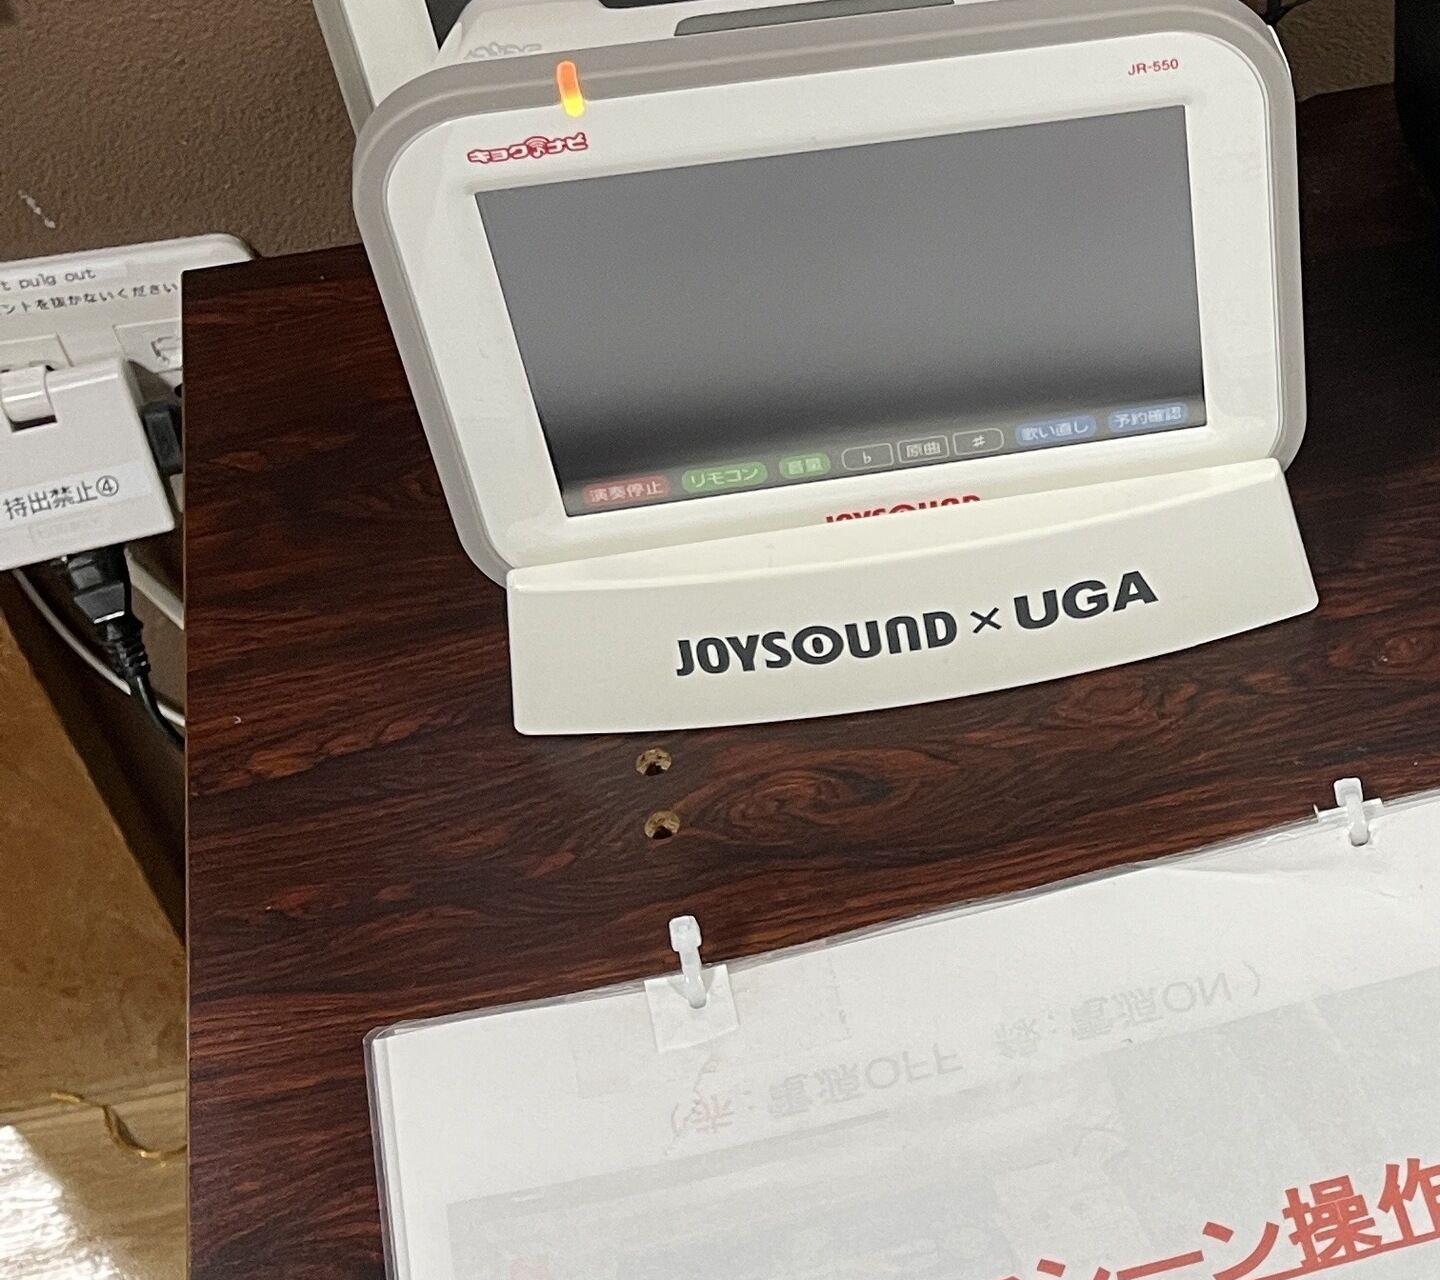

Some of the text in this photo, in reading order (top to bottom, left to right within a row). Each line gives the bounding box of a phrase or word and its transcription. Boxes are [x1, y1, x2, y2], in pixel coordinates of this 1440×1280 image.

[1127, 58, 1179, 76] JR-550
[64, 269, 97, 282] out
[589, 480, 664, 504] 演奏停止
[689, 467, 759, 489] リモコン
[905, 441, 942, 459] 原曲
[1021, 421, 1089, 443] 歌い直し
[1113, 405, 1182, 429] 予約確認
[3, 474, 120, 520] 持出禁止④
[676, 610, 958, 678] JOYSOUND
[1012, 570, 1160, 630] UGA
